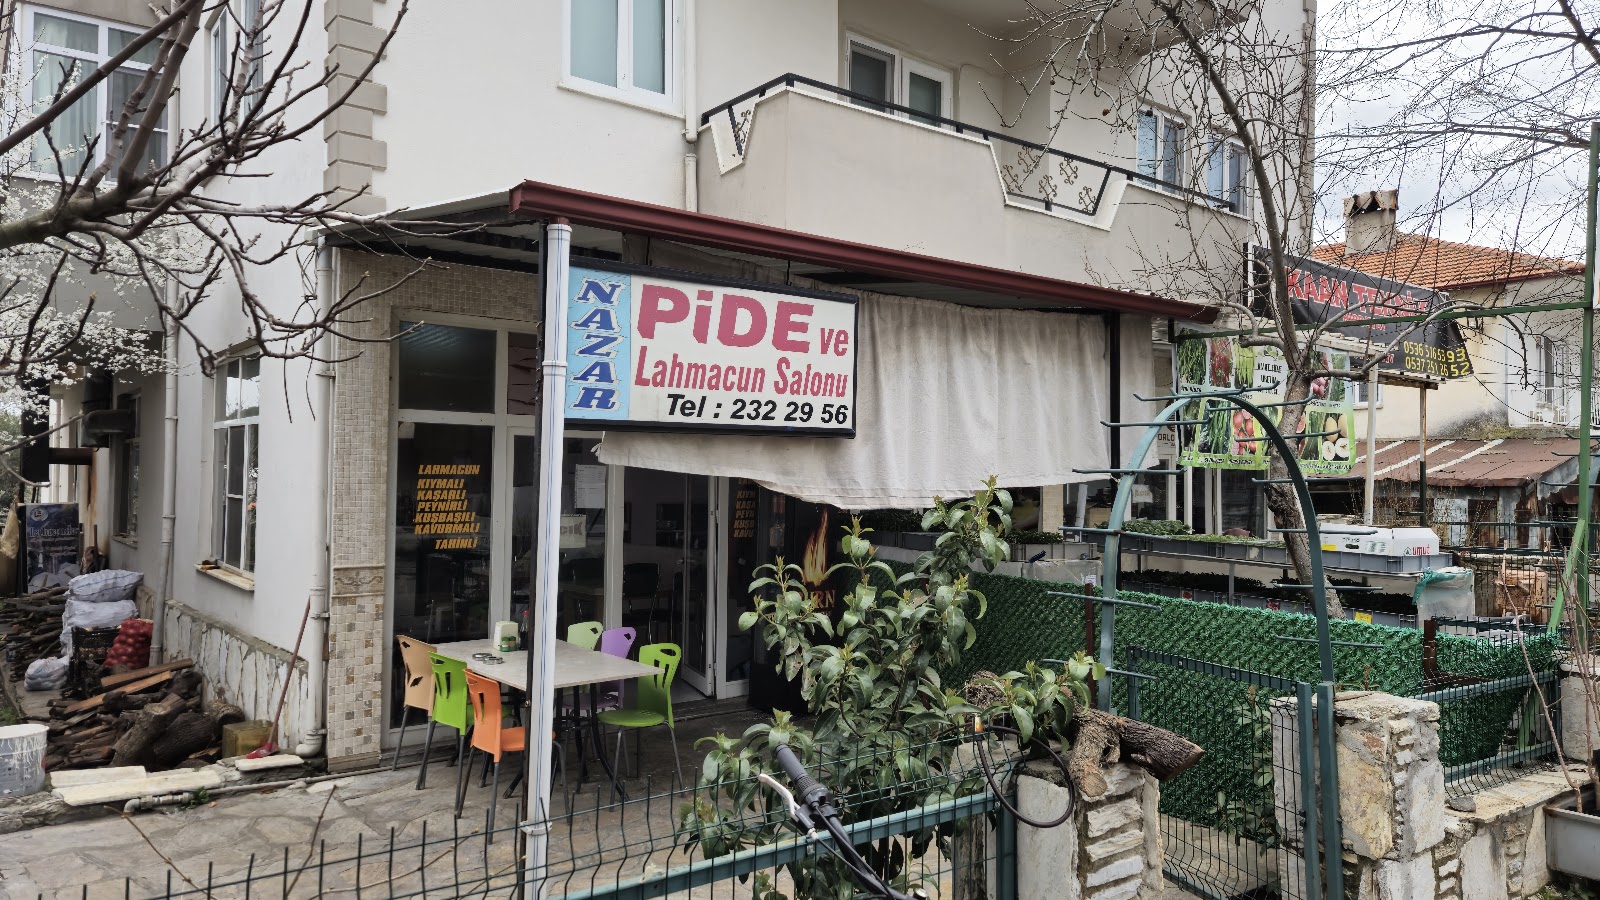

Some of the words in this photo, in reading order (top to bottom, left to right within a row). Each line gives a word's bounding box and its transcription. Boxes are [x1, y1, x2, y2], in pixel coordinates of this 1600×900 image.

[1286, 266, 1349, 310] KAAN
[571, 278, 623, 411] NAZAR
[820, 328, 849, 356] ve
[1404, 340, 1423, 357] 0536
[1446, 347, 1466, 363] 93
[634, 346, 766, 393] Lahmacun
[773, 357, 849, 398] Salonu
[1405, 356, 1425, 371] 0537
[1450, 362, 1471, 377] 52
[666, 394, 707, 418] Tel
[730, 399, 778, 421] 232
[784, 402, 814, 423] 29
[820, 404, 849, 424] 56
[418, 465, 480, 475] LAHMACUN
[417, 479, 465, 489] KIYMALI
[417, 490, 466, 501] KAŞARLI
[417, 500, 468, 511] PEYNİRLİ
[415, 512, 476, 523] KUŞBAŞILI
[415, 523, 480, 534] KAVURMALI
[435, 537, 478, 549] TAHİNLİ
[1412, 544, 1430, 556] umut
